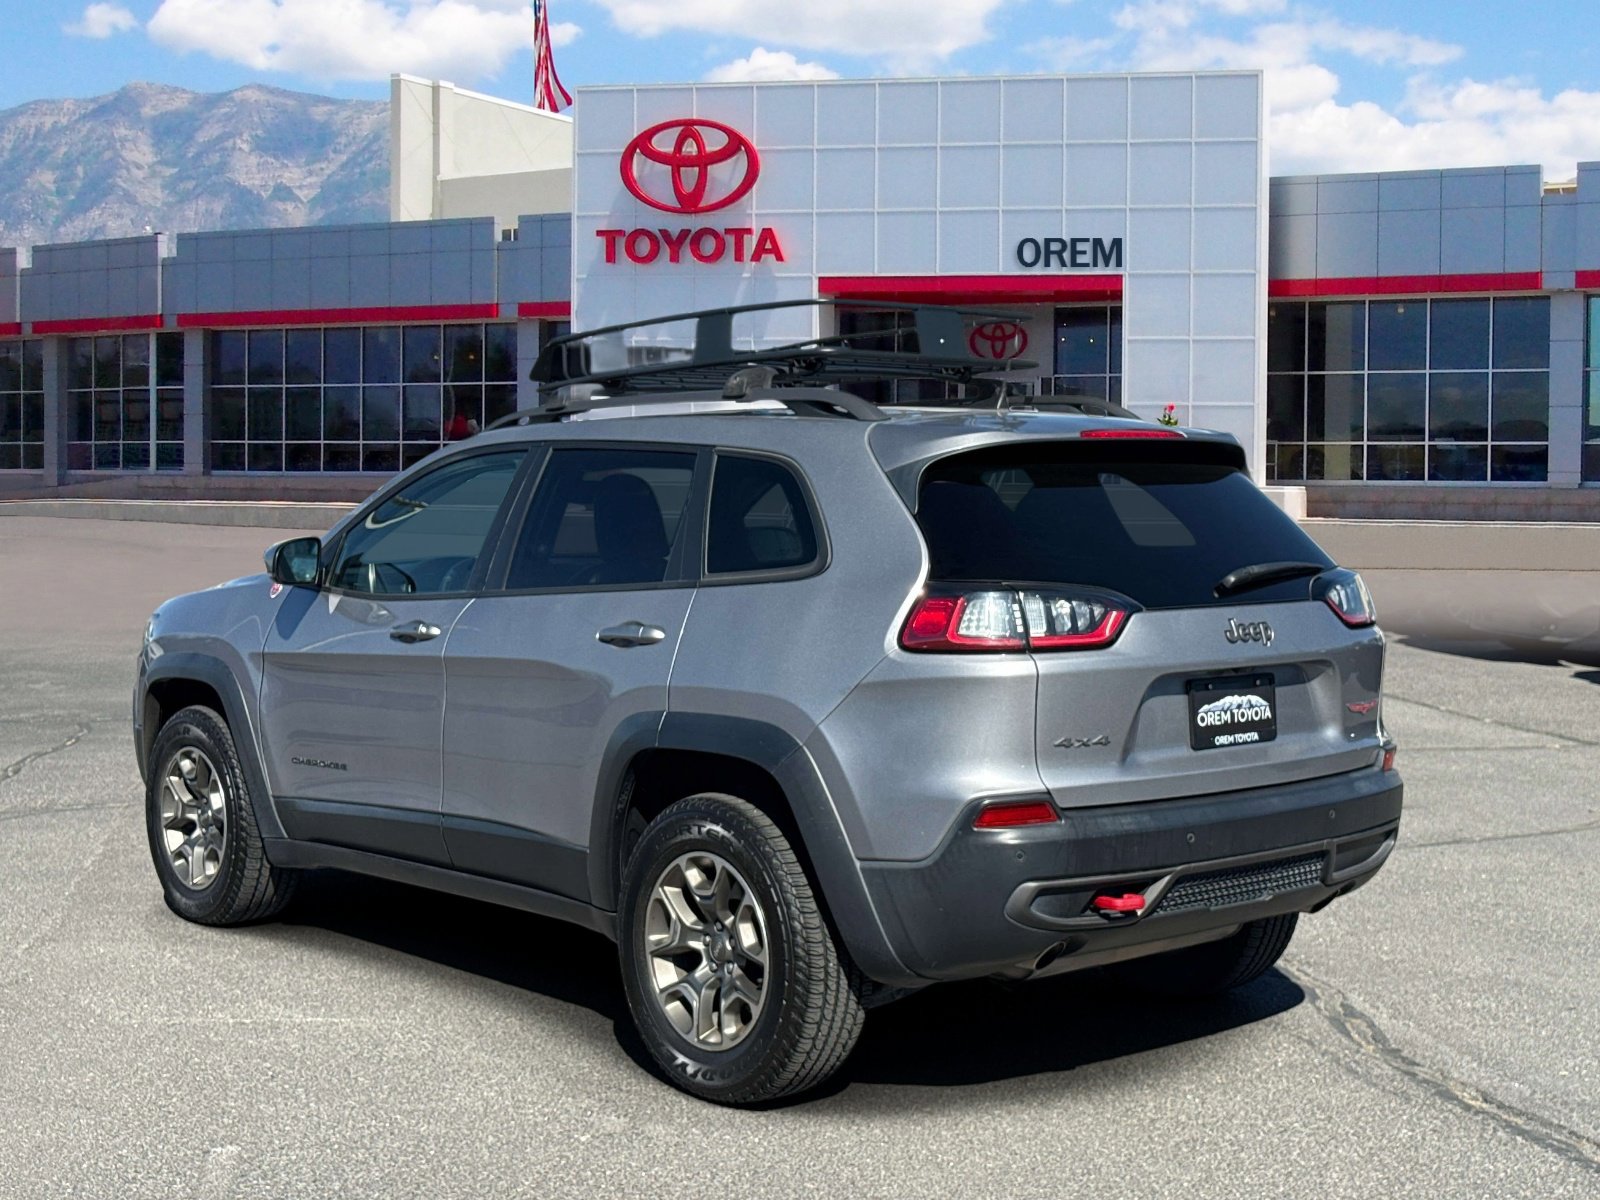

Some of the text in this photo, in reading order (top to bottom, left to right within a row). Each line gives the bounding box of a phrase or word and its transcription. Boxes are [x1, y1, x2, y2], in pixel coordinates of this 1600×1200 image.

[596, 227, 785, 264] TOYOTA
[1017, 237, 1123, 268] OREM
[1224, 617, 1274, 647] Jeep
[1197, 705, 1272, 727] OREM TOYOTA
[1215, 732, 1259, 746] OREM TOYOTA
